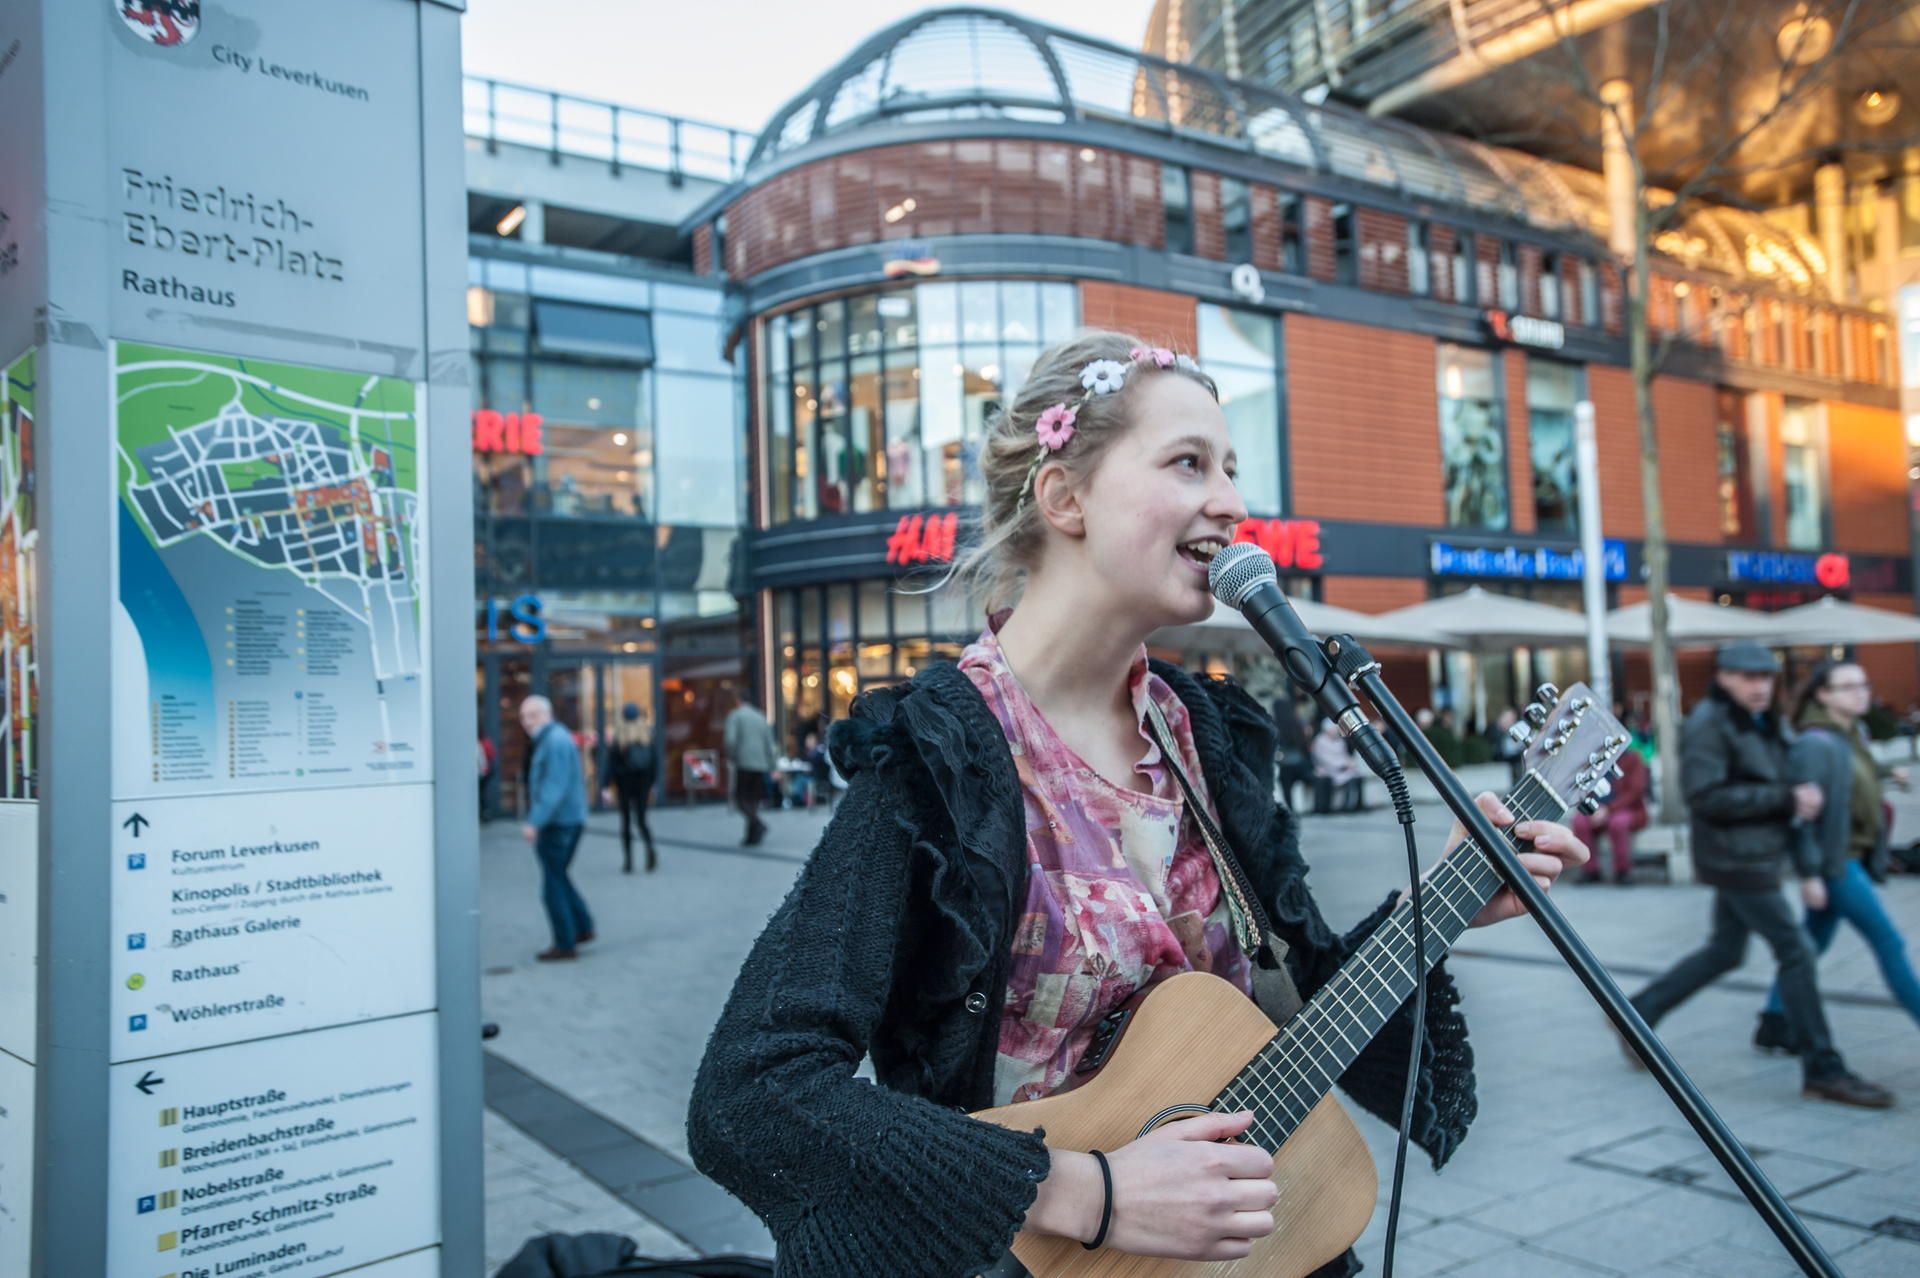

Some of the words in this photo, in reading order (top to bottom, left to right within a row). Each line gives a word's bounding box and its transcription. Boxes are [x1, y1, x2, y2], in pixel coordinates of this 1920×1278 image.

[212, 44, 252, 73] City
[259, 56, 371, 101] Leverkusen
[122, 168, 313, 232] Friedrich-
[123, 212, 344, 282] Ebert-Platz
[122, 269, 236, 308] Rathaus
[472, 409, 543, 455] RIE
[172, 848, 226, 863] Forum
[231, 840, 320, 858] Leverkusen
[172, 882, 250, 902] Kinopolis
[265, 869, 383, 893] Stadtbibliothek
[172, 924, 240, 944] Rathaus
[245, 915, 301, 934] Galerie
[172, 963, 240, 983] Rathaus
[171, 993, 285, 1023] Wöhlerstraße
[183, 1089, 286, 1120] Hauptstraße
[183, 1118, 335, 1161] Breidenbachstraße
[181, 1167, 284, 1202] Nobelstraße
[181, 1183, 377, 1244] Pfarrer-Schmitz-Straße
[182, 1267, 211, 1278] Die
[215, 1242, 307, 1276] Luminaden
